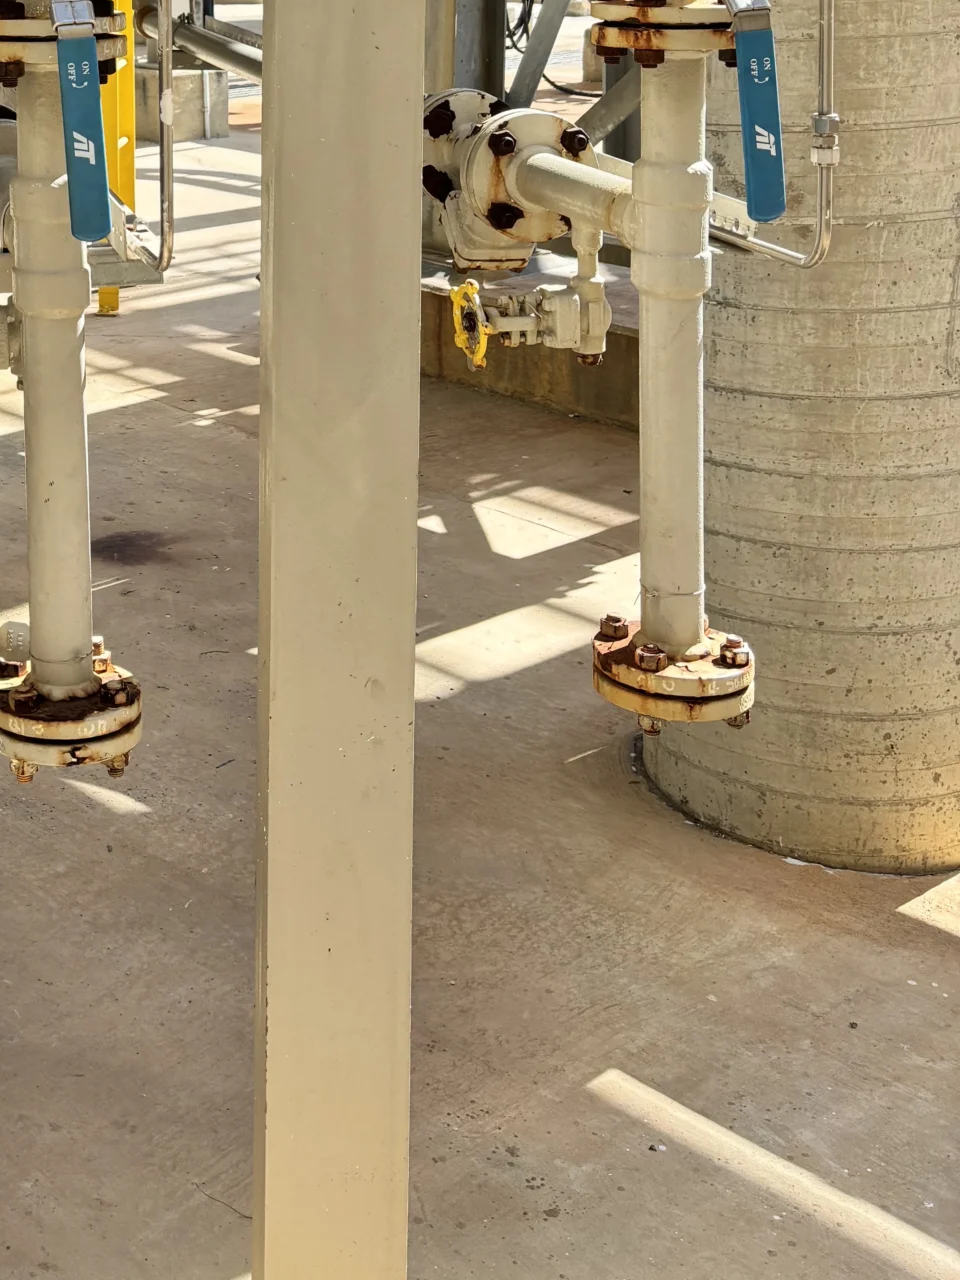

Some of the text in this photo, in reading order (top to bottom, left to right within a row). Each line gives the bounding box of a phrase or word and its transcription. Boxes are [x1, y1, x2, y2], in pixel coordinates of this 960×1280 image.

[67, 62, 76, 81] OFF
[81, 61, 90, 75] ON
[750, 58, 758, 77] OFF
[763, 57, 771, 71] ON
